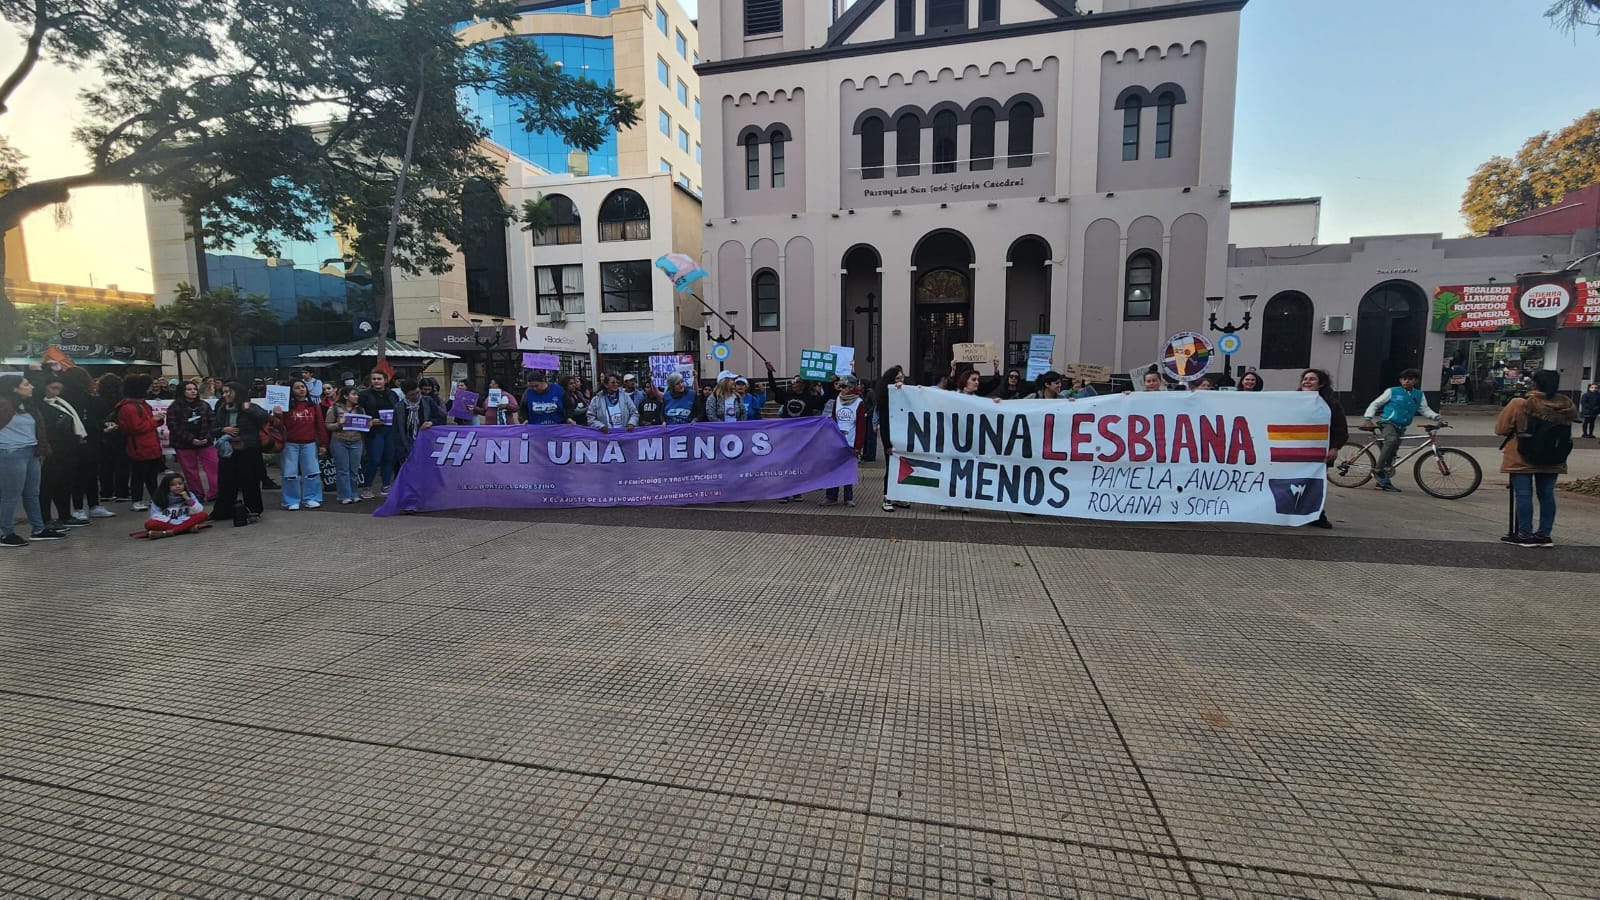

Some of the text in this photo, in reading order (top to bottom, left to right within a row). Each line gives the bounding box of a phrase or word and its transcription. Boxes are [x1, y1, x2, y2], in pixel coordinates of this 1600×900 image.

[864, 188, 908, 197] Parroquia
[910, 185, 927, 194] San
[983, 177, 1024, 189] Catedral
[1464, 294, 1509, 302] LLAVEROS
[1528, 297, 1561, 308] ROJA
[1454, 302, 1507, 311] RECUERDOS
[1467, 310, 1510, 319] REMERAS
[1461, 318, 1514, 328] SOUVENIRS
[643, 402, 657, 412] GAP
[906, 411, 1257, 466] NI UNA LESBIANA
[548, 440, 626, 465] UNA
[637, 431, 773, 462] MENOS
[949, 458, 1070, 509] MENOS
[1183, 467, 1265, 494] ANDREA
[1087, 491, 1162, 515] ROXANA
